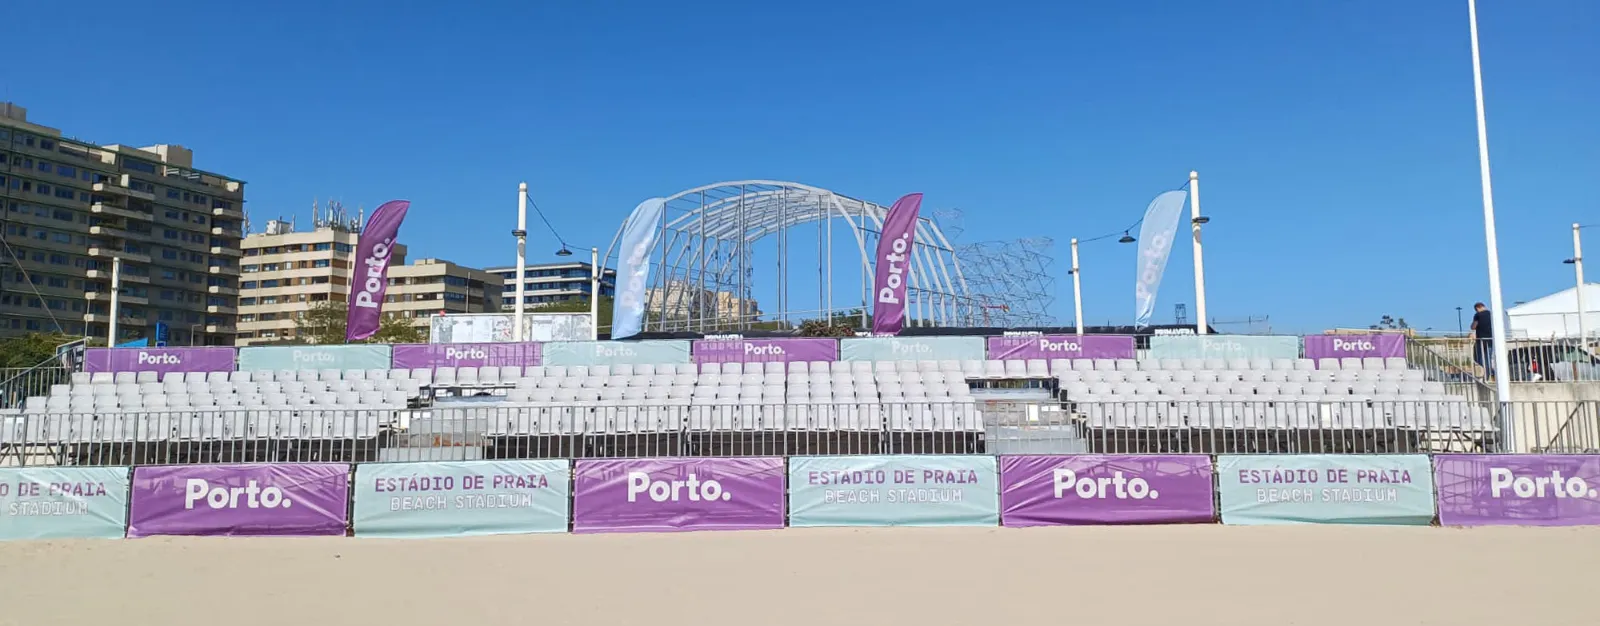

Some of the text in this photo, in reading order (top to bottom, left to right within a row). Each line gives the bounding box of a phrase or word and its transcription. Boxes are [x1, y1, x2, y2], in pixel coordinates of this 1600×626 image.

[355, 238, 391, 308] Porto.
[877, 232, 909, 304] Porto.
[595, 344, 637, 357] Porto.
[744, 343, 786, 354] Porto.
[1040, 340, 1081, 351] Porto.
[1333, 339, 1376, 351] Porto.
[138, 352, 181, 364] Porto.
[445, 347, 488, 359] Porto.
[894, 469, 915, 484] DE
[923, 469, 978, 484] PRAIA
[1239, 465, 1412, 484] ESTÁDIO DE PRAIA
[18, 482, 40, 496] DE
[49, 482, 106, 497] PRAIA
[375, 473, 548, 492] ESTÁDIO DE PRAIA
[627, 472, 732, 503] Porto.
[1053, 468, 1159, 499] Porto.
[1489, 467, 1598, 498] Porto.
[184, 478, 292, 509] Porto.
[824, 488, 963, 504] BEACH STADIUM
[1257, 488, 1397, 502] BEACH STADIUM
[9, 501, 88, 516] STADIUM
[390, 493, 532, 512] BEACH STADIUM
